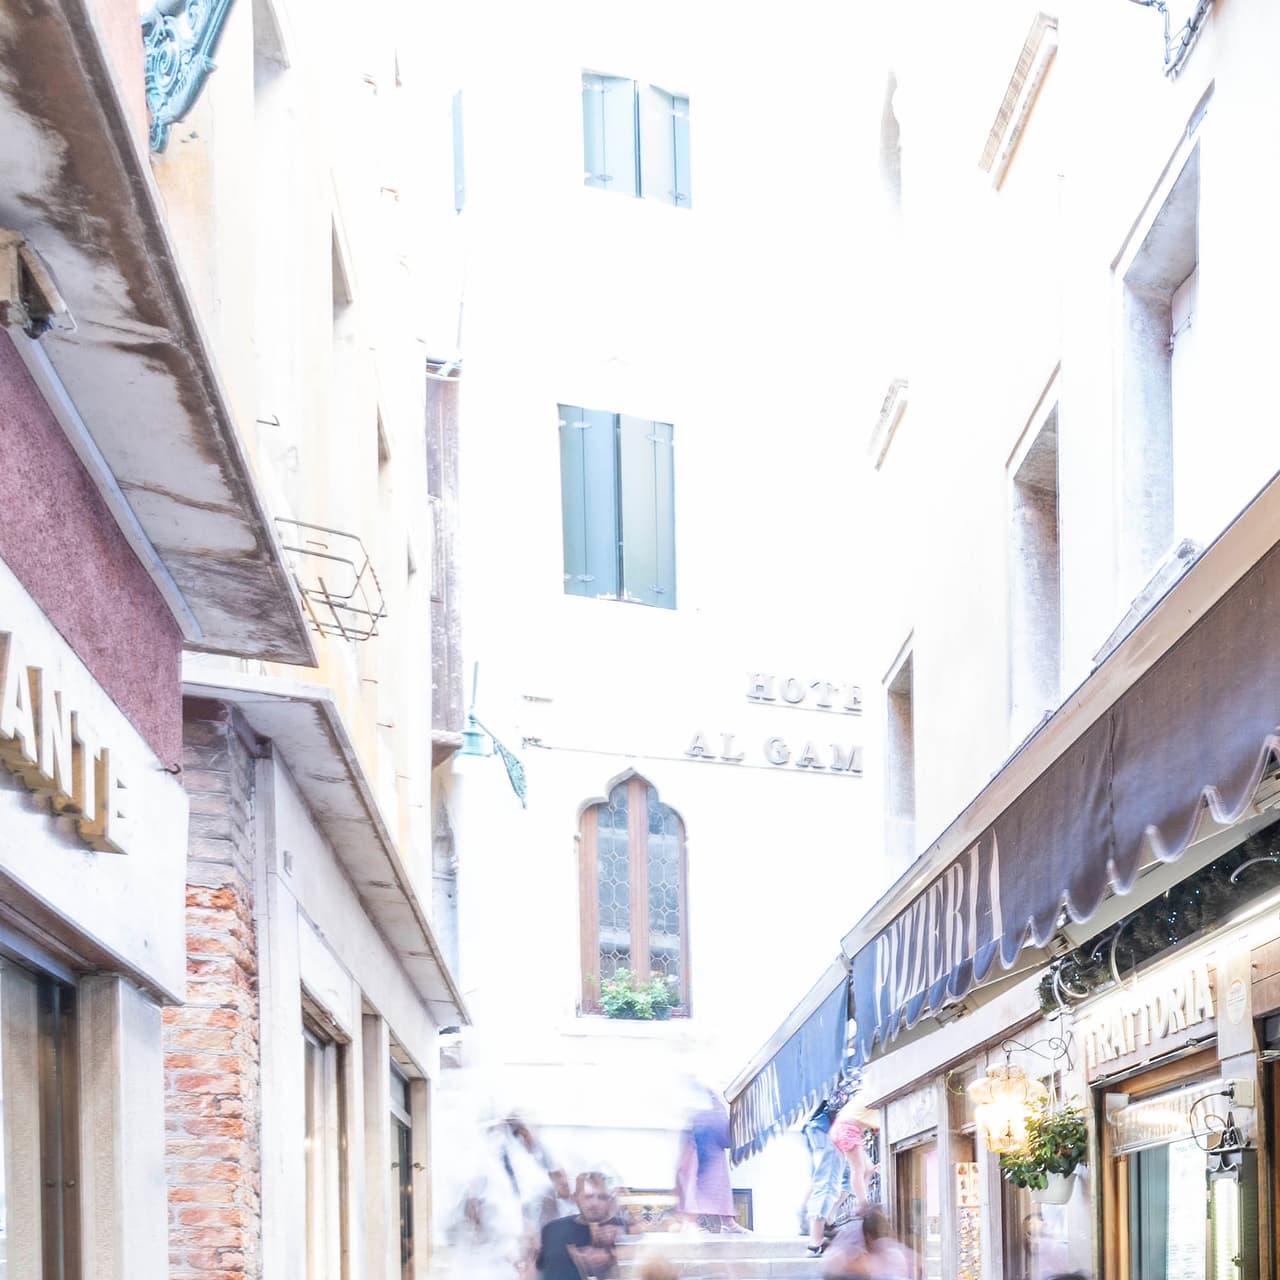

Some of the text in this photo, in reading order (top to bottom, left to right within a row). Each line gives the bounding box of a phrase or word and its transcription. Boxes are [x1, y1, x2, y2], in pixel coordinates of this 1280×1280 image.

[684, 731, 745, 762] AL
[874, 826, 1007, 1030] PIZZERIA
[1082, 961, 1216, 1069] TRATTORIA
